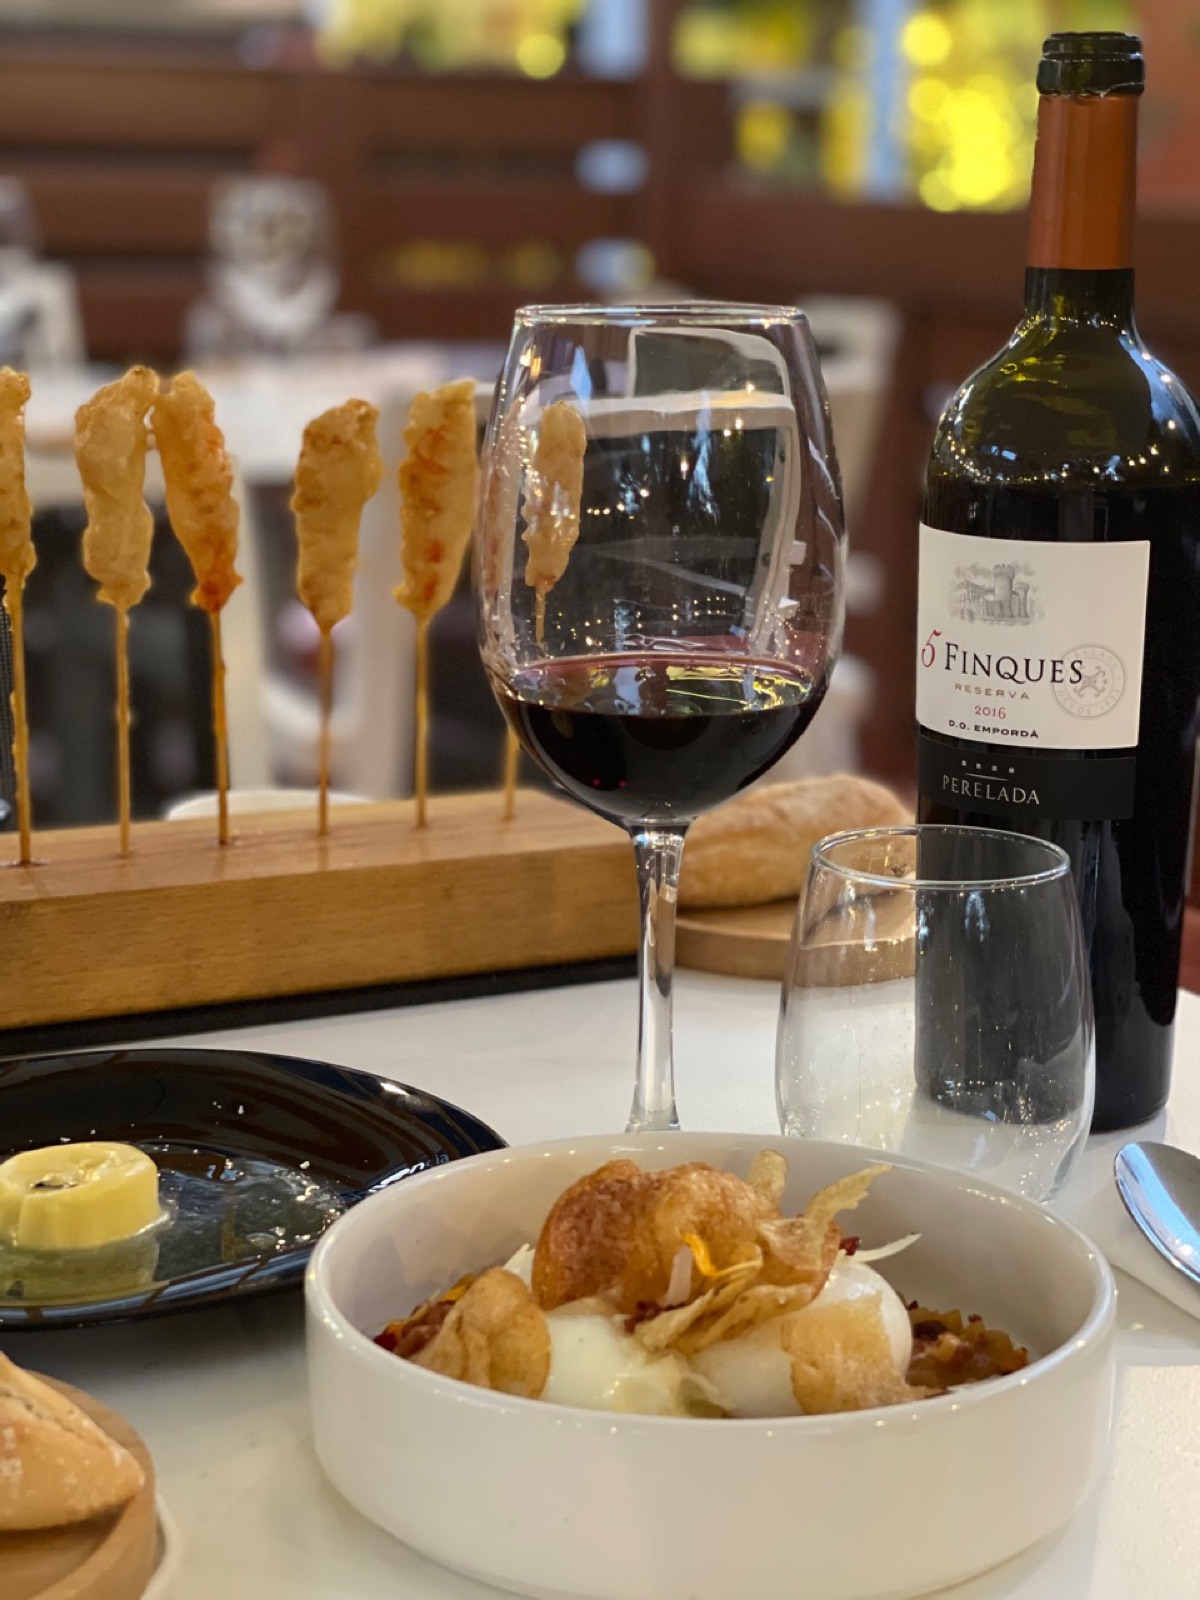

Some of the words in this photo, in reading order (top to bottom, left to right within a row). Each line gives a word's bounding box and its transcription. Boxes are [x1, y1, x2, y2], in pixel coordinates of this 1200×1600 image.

[921, 629, 941, 668] 5
[944, 641, 1083, 685] FINQUES
[954, 683, 1030, 700] RESERVA
[974, 705, 1007, 720] 2016
[948, 719, 971, 731] D.O.
[942, 774, 1040, 805] PERELADA
